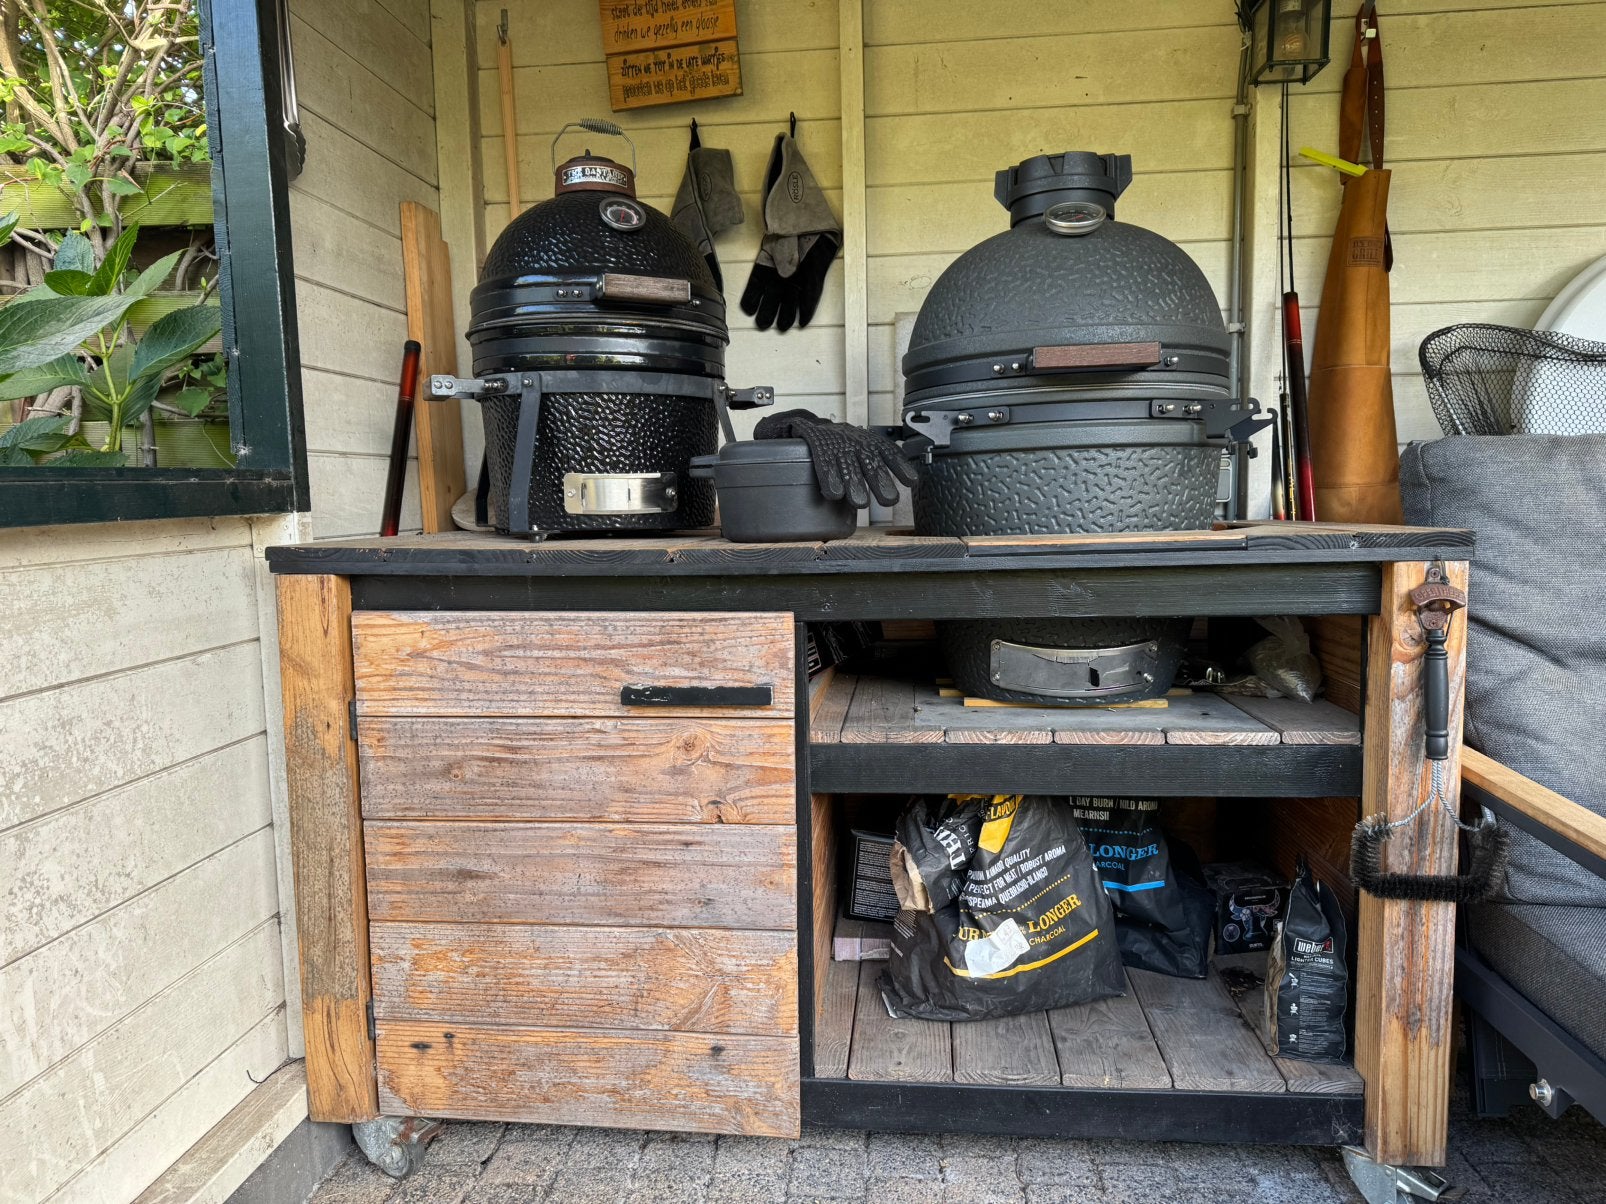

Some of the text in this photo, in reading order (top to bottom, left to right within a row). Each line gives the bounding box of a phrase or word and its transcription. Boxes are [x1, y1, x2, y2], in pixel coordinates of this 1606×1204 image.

[614, 22, 638, 43] drinken
[640, 25, 651, 39] we
[681, 18, 693, 32] een
[653, 60, 666, 76] TOT
[676, 58, 684, 70] DE
[685, 55, 699, 68] LATE
[1093, 798, 1114, 808] BURN
[1073, 808, 1110, 821] MEARNSII
[1004, 848, 1031, 868] QUALITY
[1088, 843, 1159, 861] LONGER
[993, 877, 1007, 891] FOR
[1003, 868, 1018, 884] MEAT
[1020, 854, 1043, 874] ROBUST
[1044, 845, 1066, 862] AROMA
[1095, 861, 1125, 871] ARCOAL
[1027, 893, 1082, 933] LONGER
[1028, 925, 1066, 946] CHARCOAL
